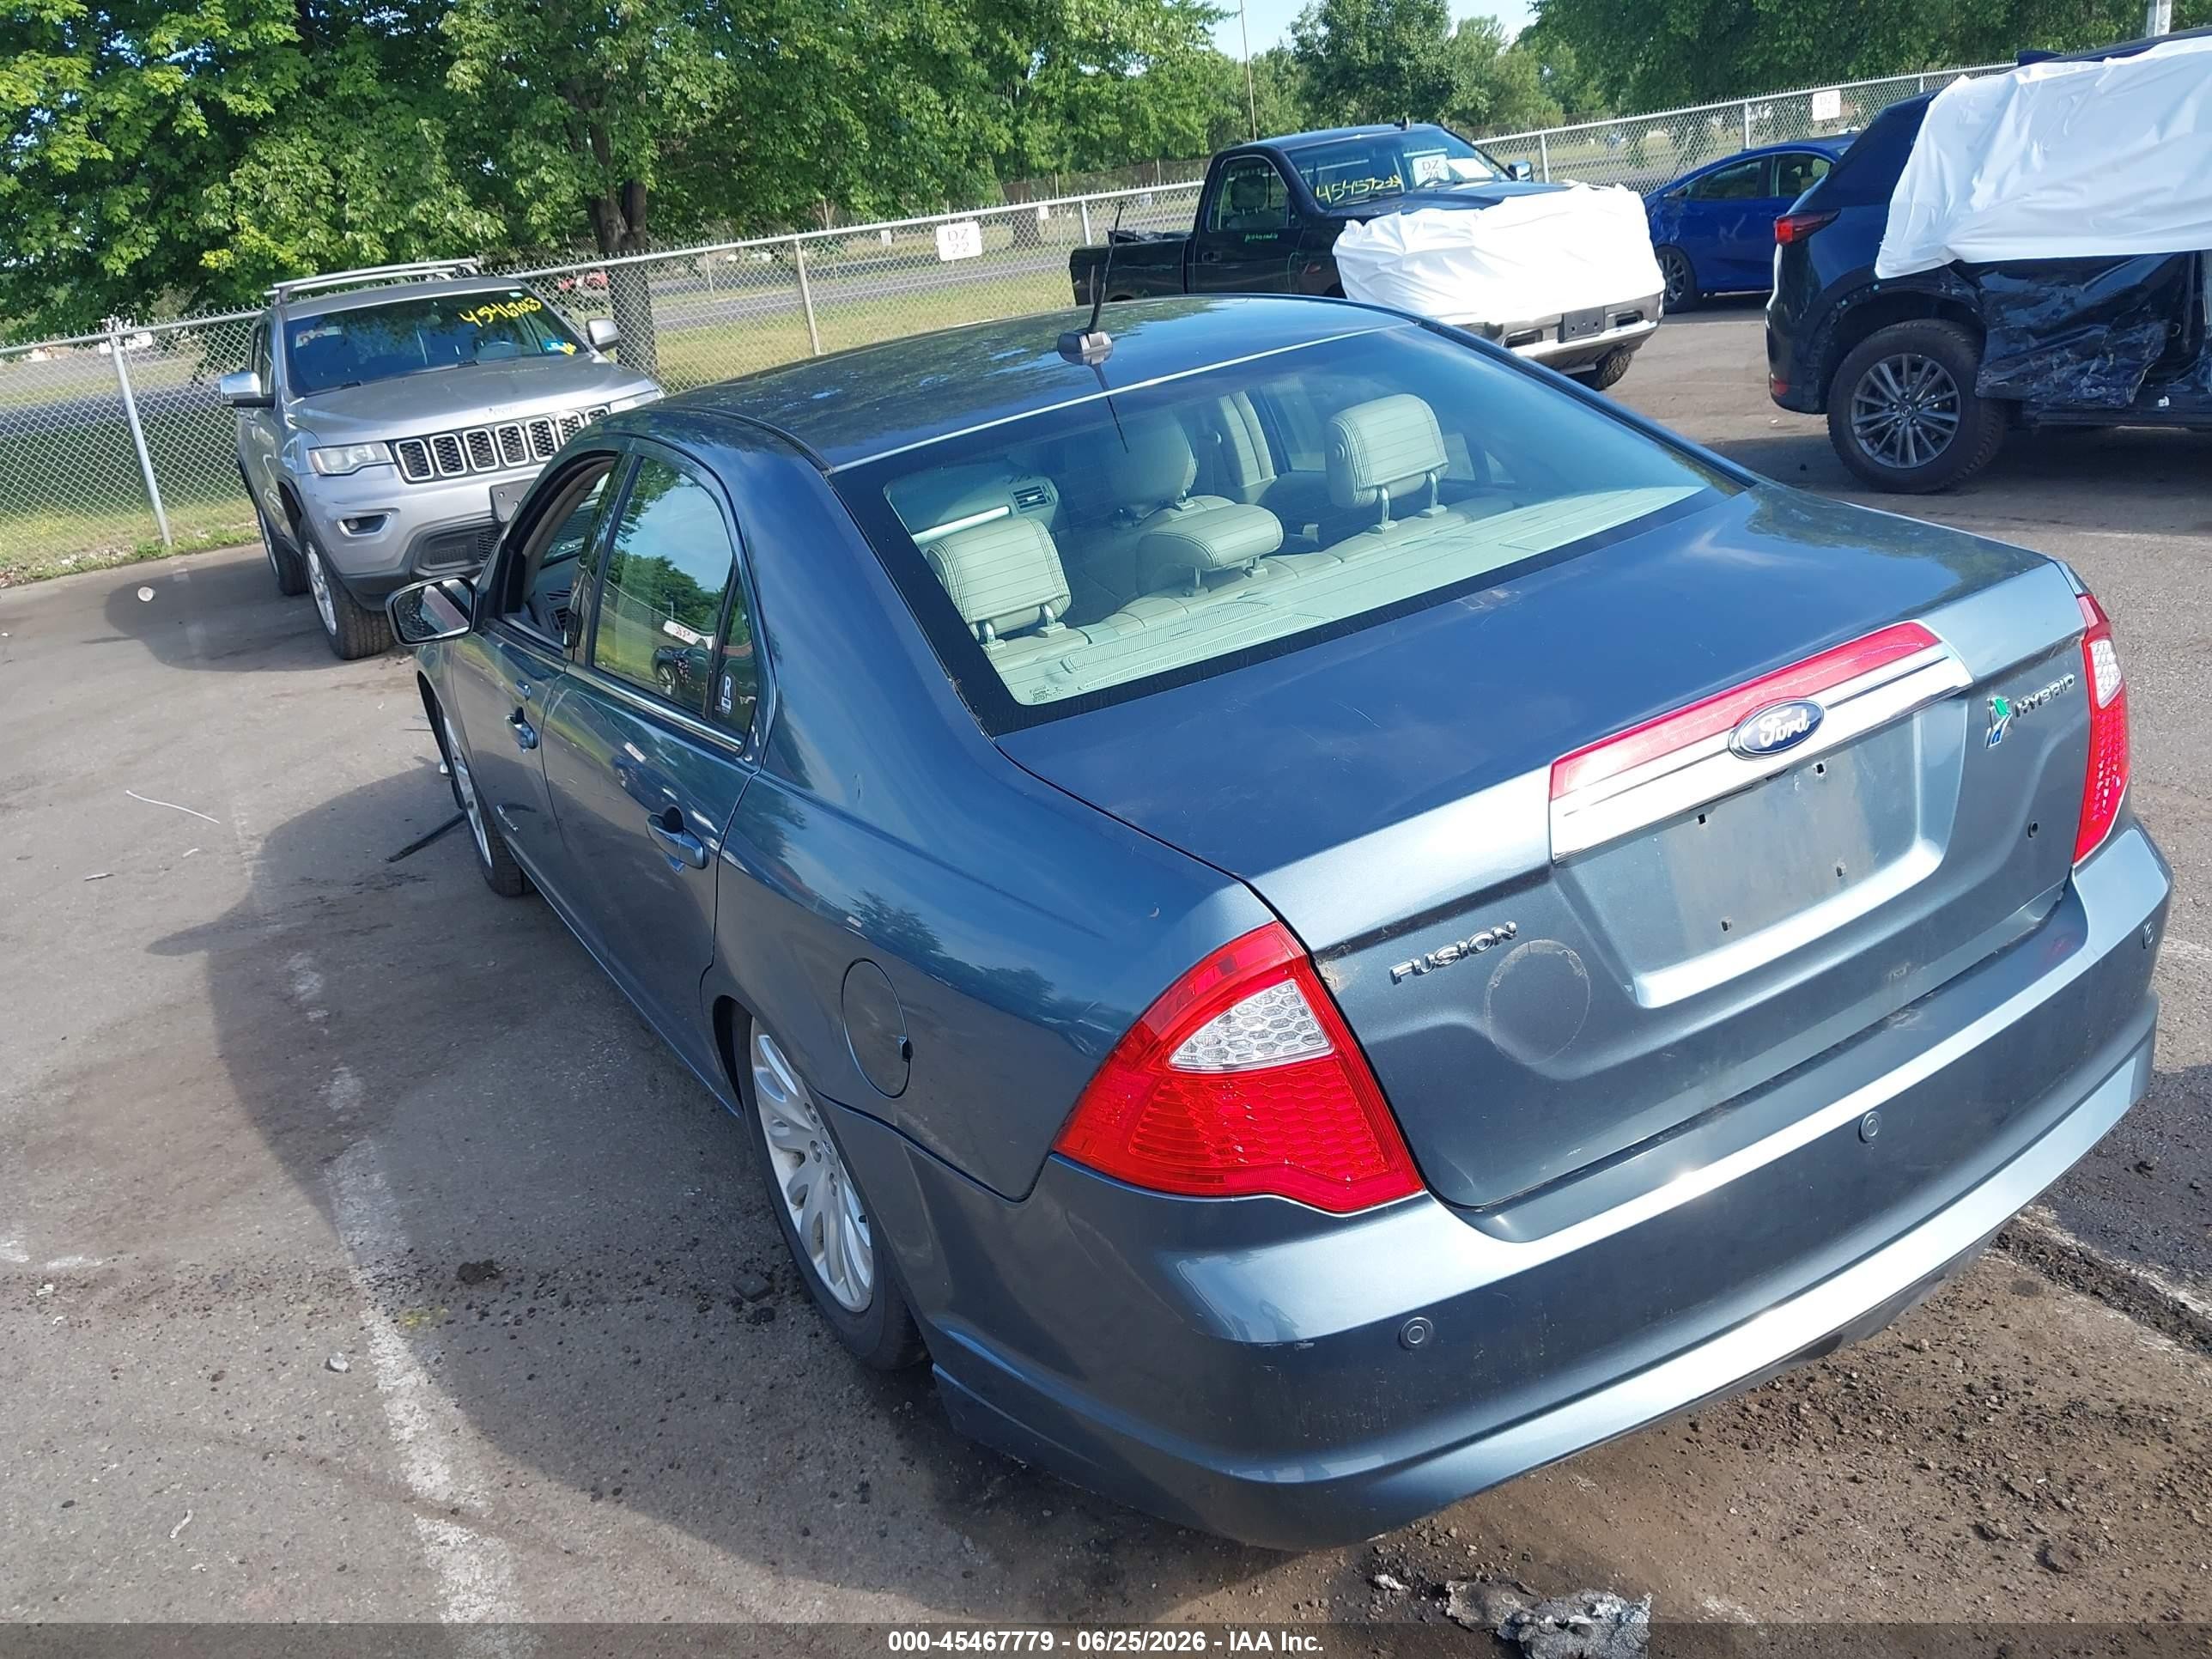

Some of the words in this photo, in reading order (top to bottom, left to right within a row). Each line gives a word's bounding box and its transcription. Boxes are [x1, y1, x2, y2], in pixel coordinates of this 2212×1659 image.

[1422, 160, 1439, 171] DZ
[947, 228, 969, 241] DZ
[950, 241, 969, 253] 22
[724, 675, 732, 698] R
[2014, 673, 2075, 718] HYBRID
[1758, 707, 1810, 749] Ford
[1388, 920, 1518, 986] FUSION
